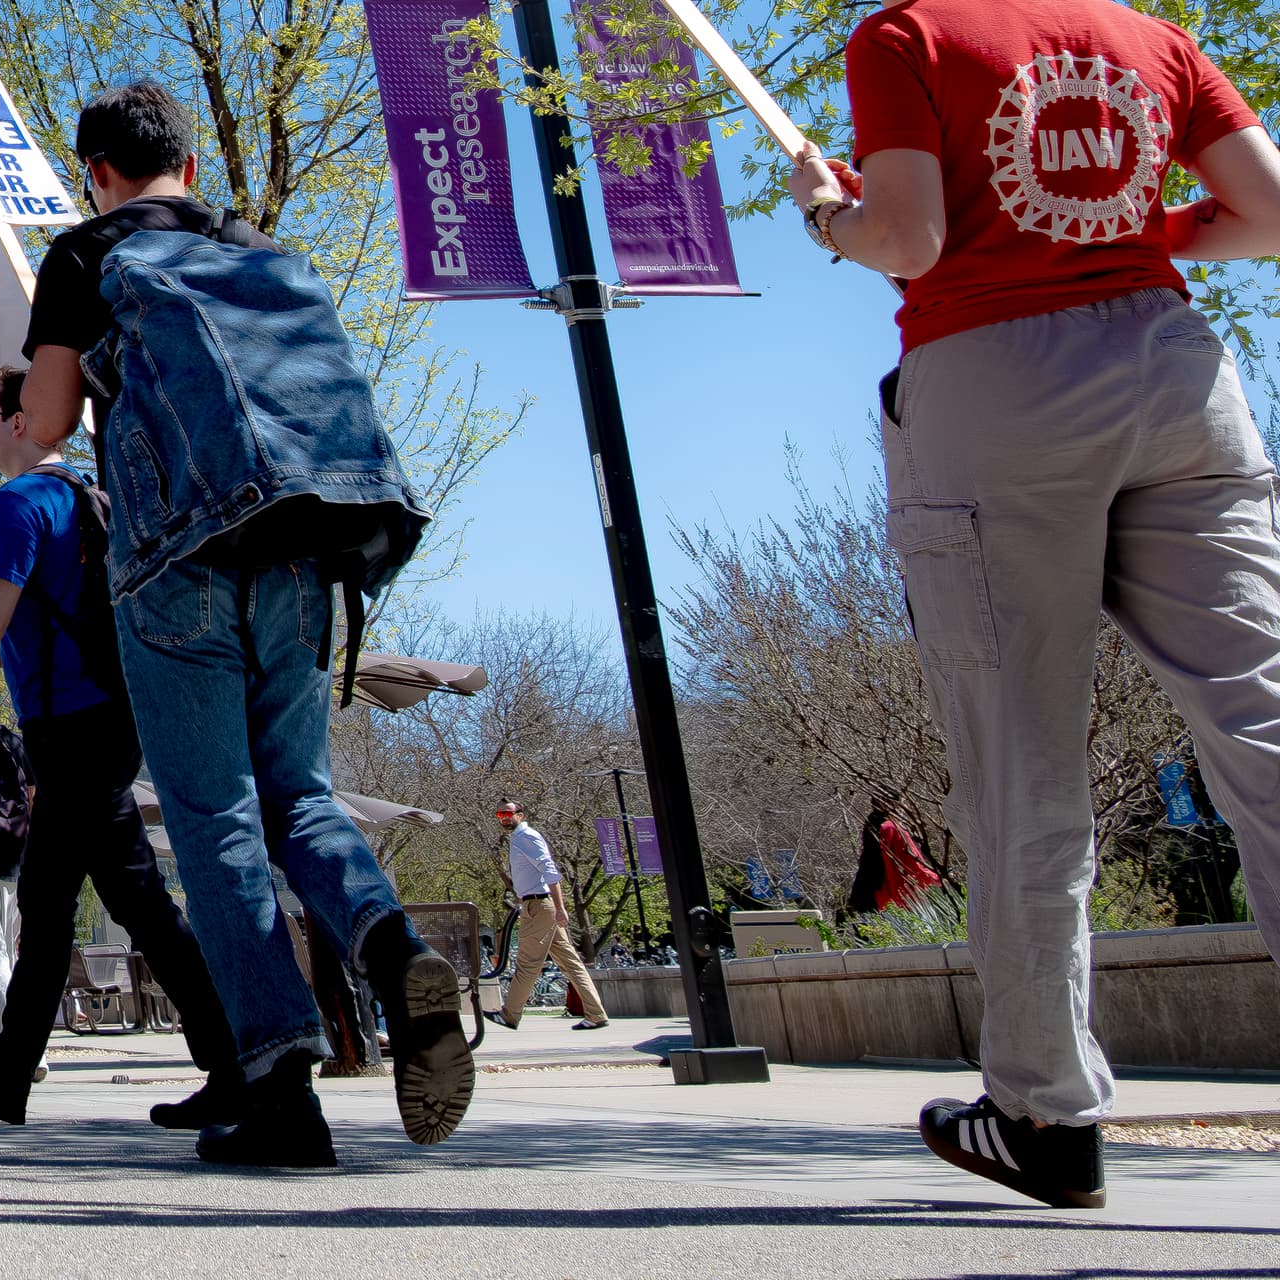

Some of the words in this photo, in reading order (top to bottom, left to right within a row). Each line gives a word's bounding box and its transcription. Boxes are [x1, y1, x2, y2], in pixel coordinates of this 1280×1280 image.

[432, 17, 489, 204] research
[596, 64, 616, 74] UC
[1038, 127, 1125, 171] UAW
[415, 128, 468, 276] Expect
